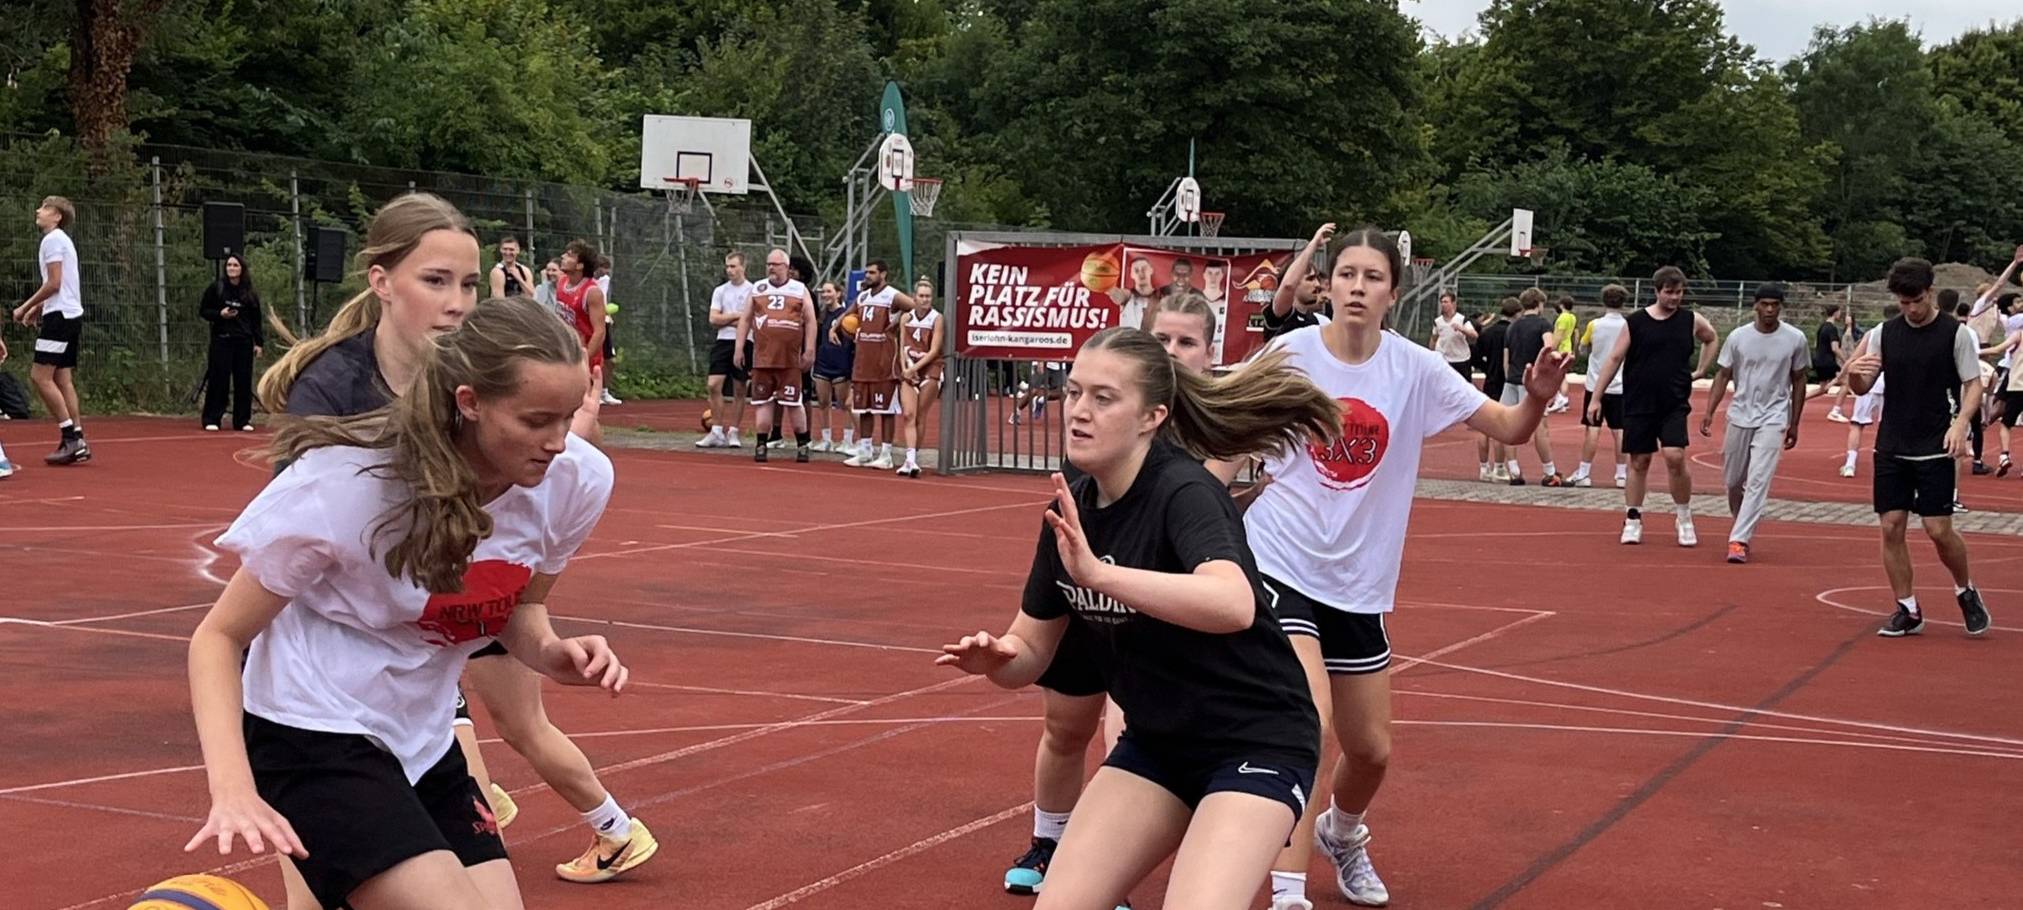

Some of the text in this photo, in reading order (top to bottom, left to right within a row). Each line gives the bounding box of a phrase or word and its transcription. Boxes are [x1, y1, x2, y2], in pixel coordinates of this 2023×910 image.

[969, 263, 1028, 285] KEIN
[968, 281, 1090, 307] PLATZ FÜR
[767, 295, 785, 310] 23
[862, 306, 875, 322] 14
[968, 305, 1109, 329] RASSISMUS!
[912, 327, 921, 342] 4
[784, 385, 796, 396] 23
[874, 393, 883, 403] 14
[485, 591, 520, 616] TOU
